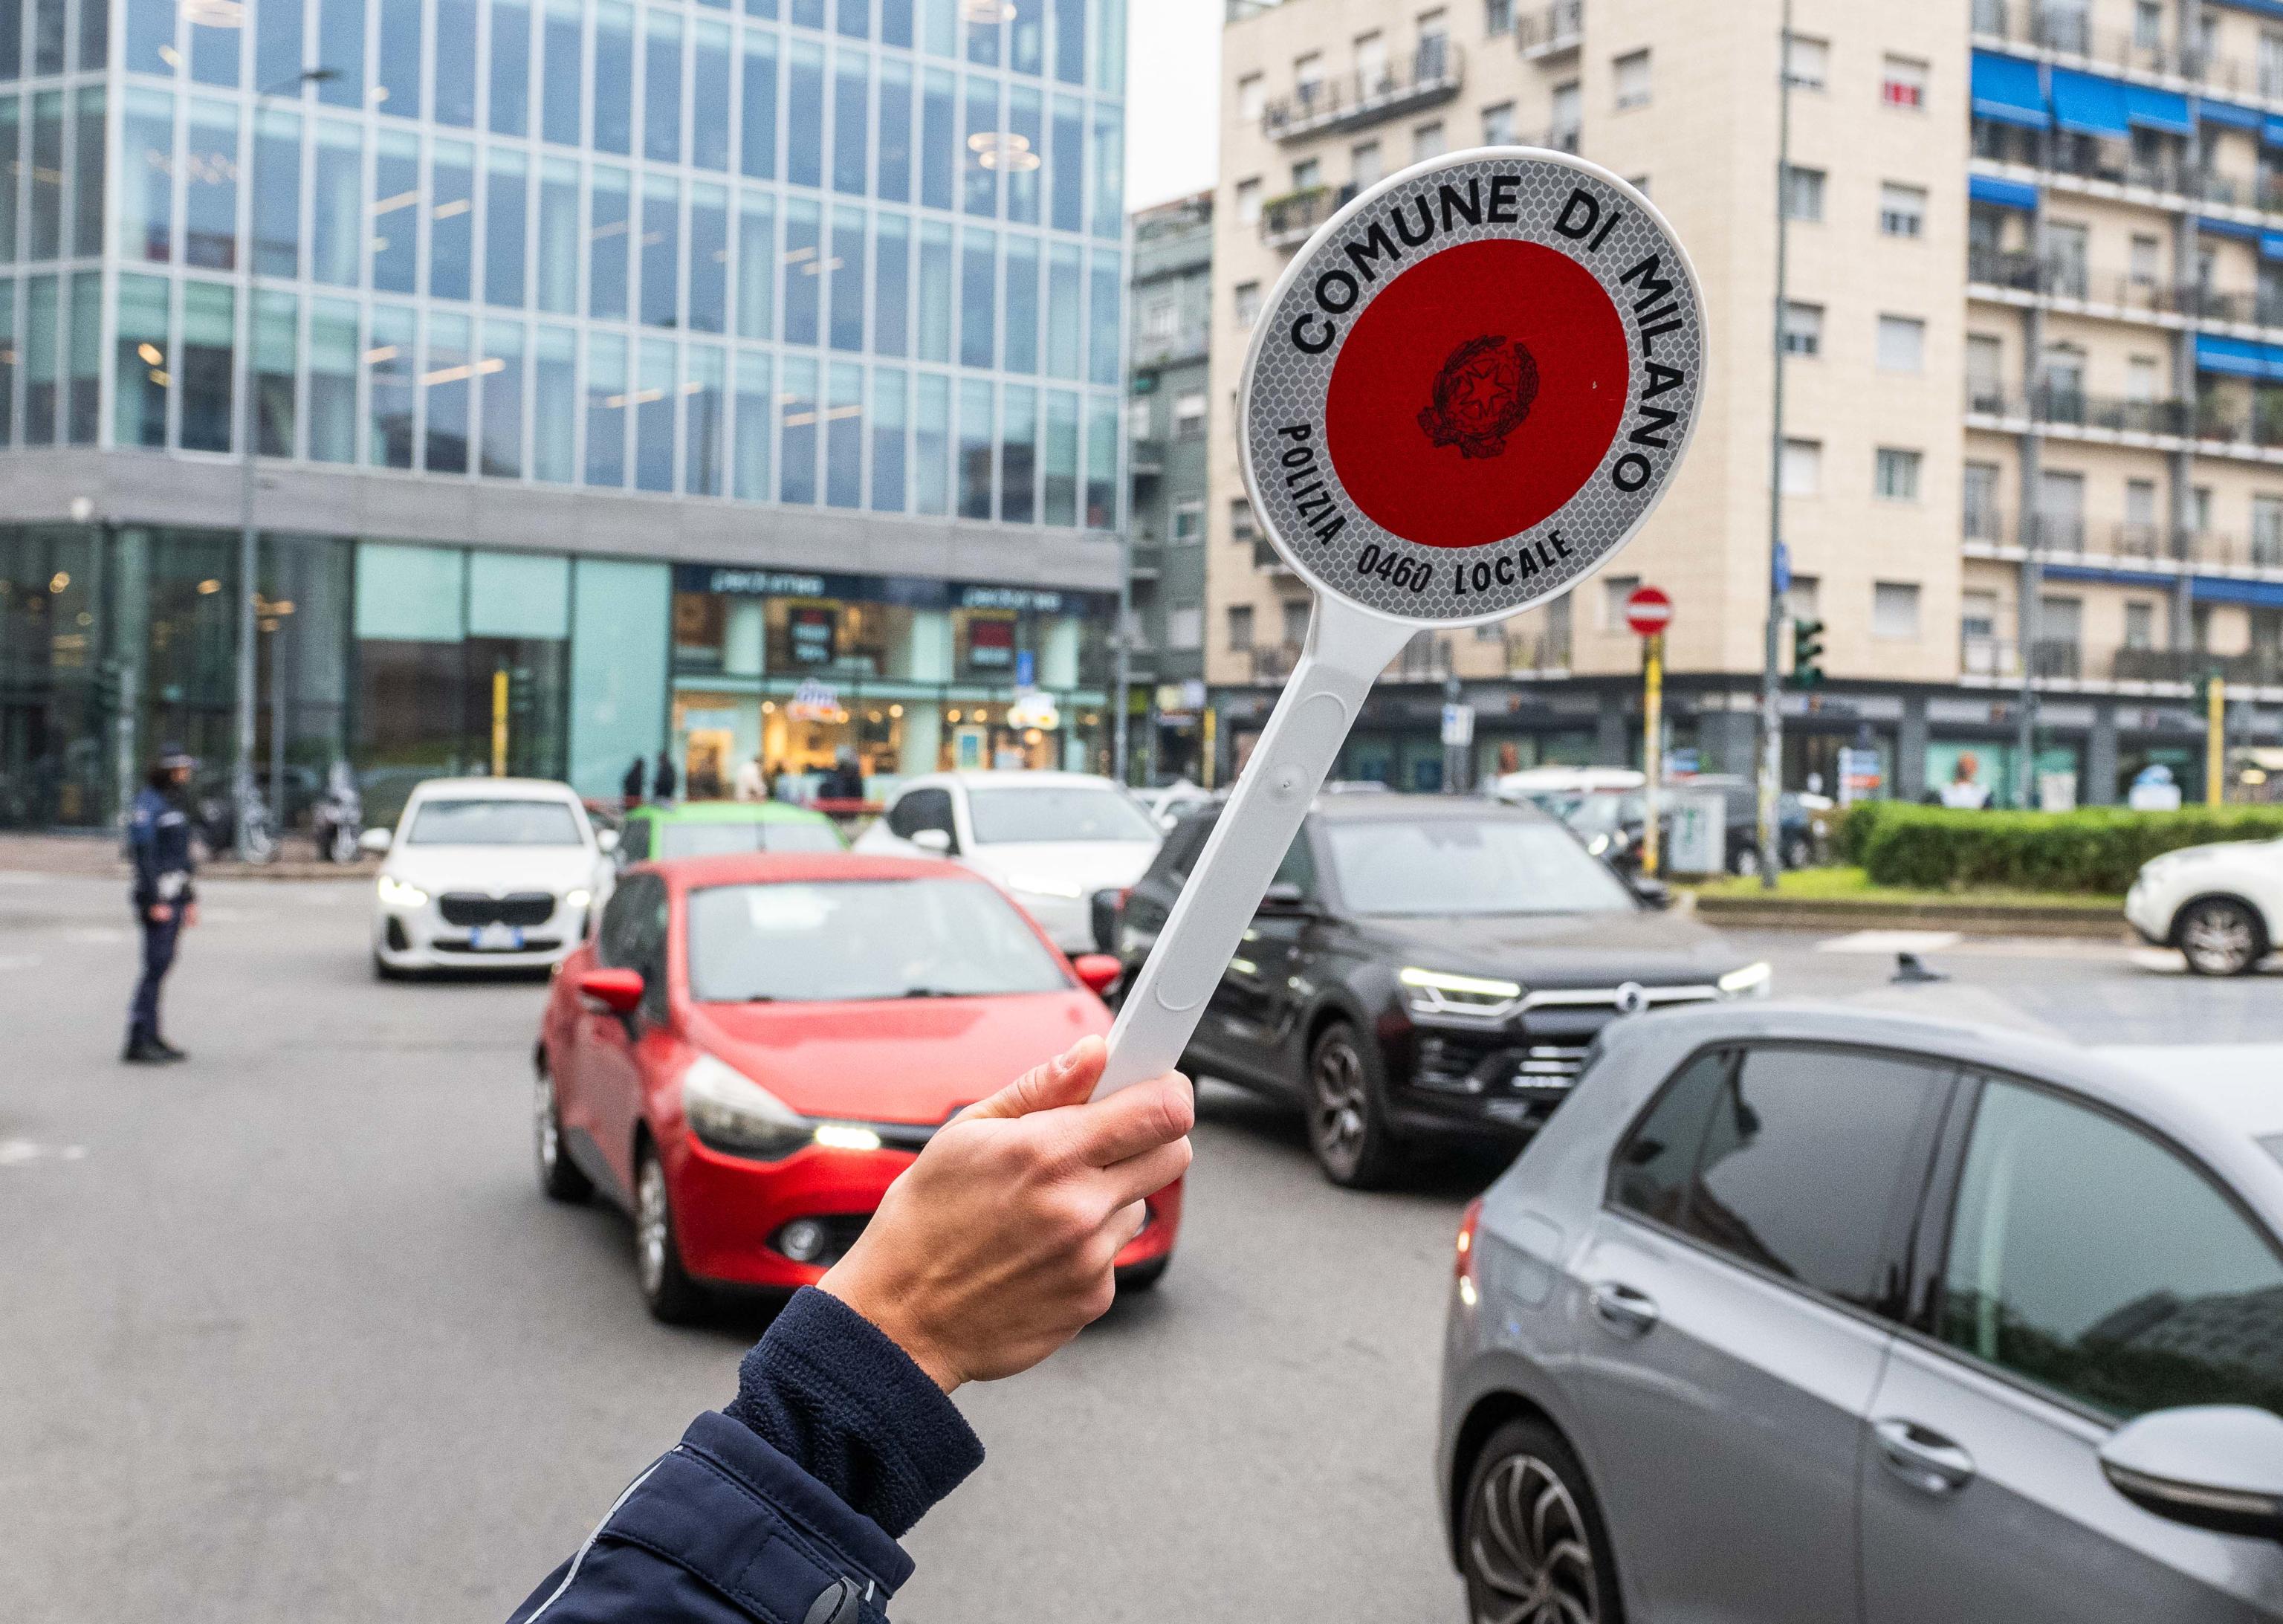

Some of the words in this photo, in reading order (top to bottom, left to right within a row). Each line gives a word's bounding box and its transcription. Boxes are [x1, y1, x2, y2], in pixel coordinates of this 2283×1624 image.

[1290, 175, 1521, 355] COMUNE
[1552, 188, 1621, 253] DI
[1611, 253, 1685, 494] MILANO
[1277, 424, 1347, 546] POLIZIA
[1357, 543, 1433, 594] 0460
[1455, 529, 1573, 595] LOCALE
